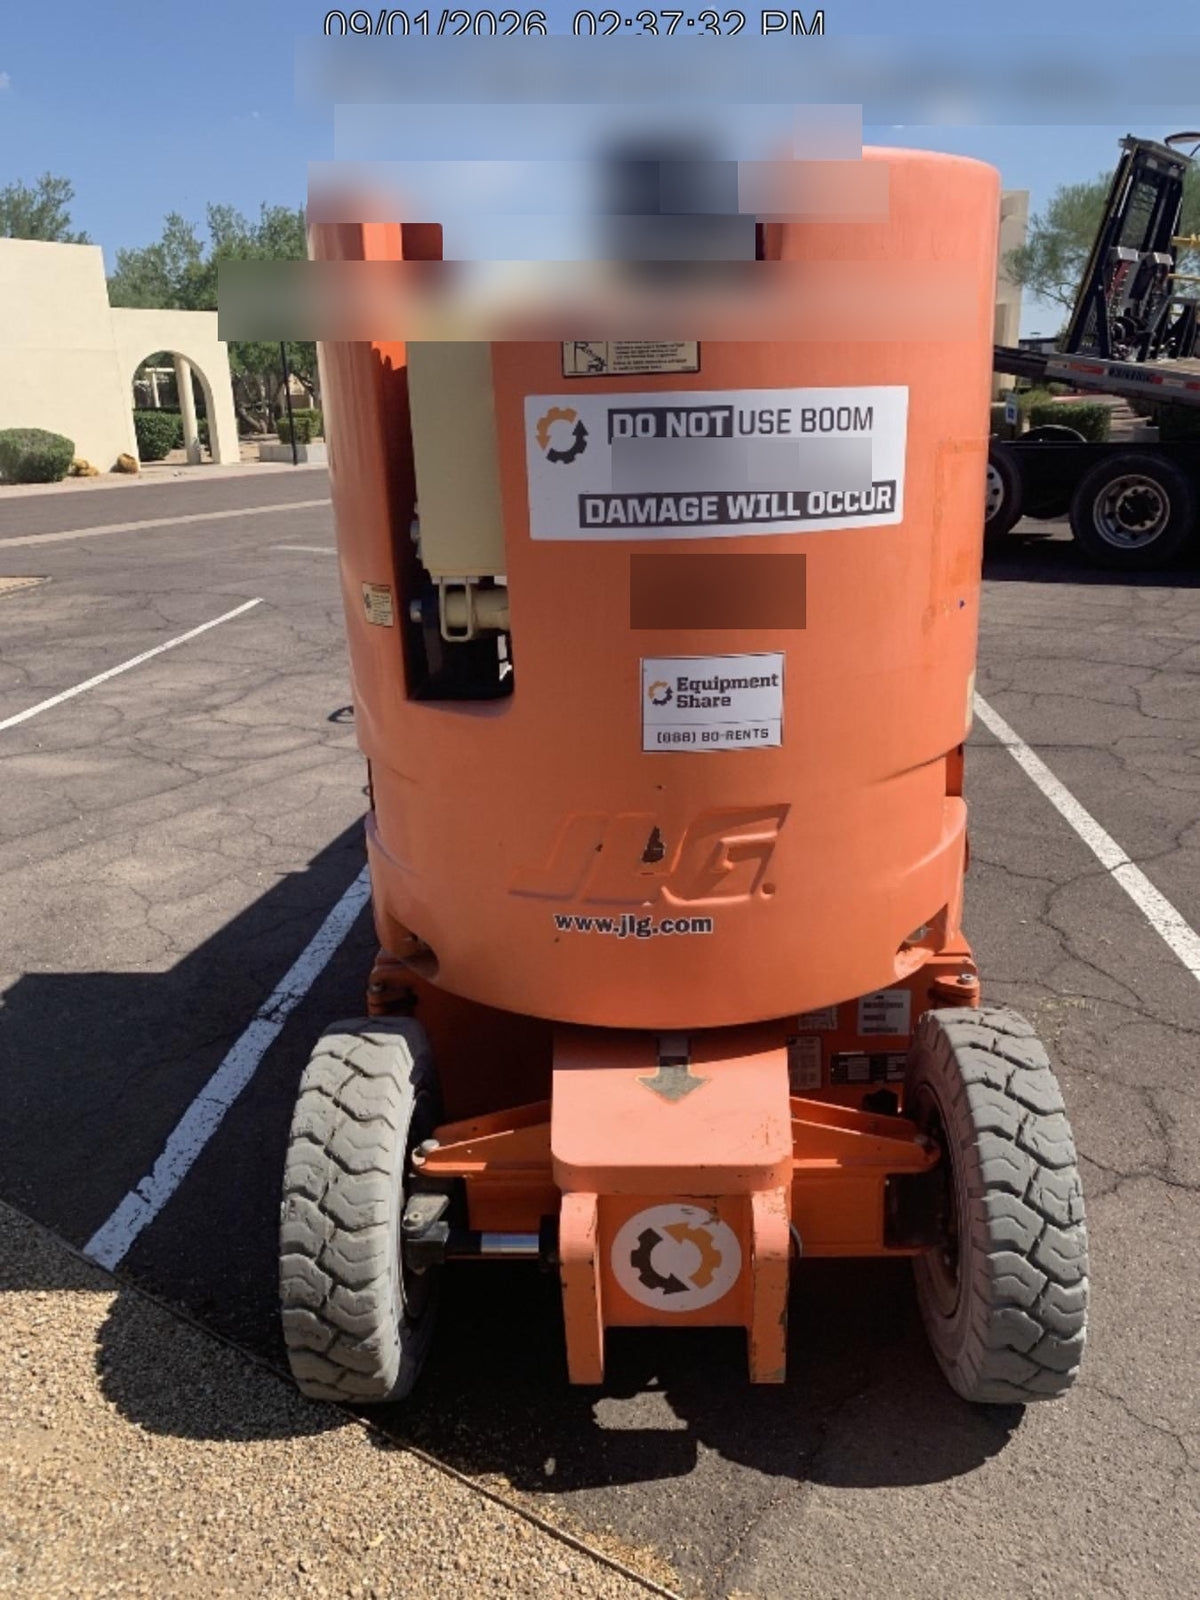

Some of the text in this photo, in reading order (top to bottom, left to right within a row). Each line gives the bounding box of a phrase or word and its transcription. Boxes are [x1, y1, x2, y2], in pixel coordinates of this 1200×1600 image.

[612, 406, 874, 438] DO NOT USE BOOM
[584, 486, 893, 525] DAMAGE WILL OCCUR
[676, 673, 779, 694] Equipment
[676, 694, 732, 709] Share
[553, 913, 713, 938] www.jlg.com
